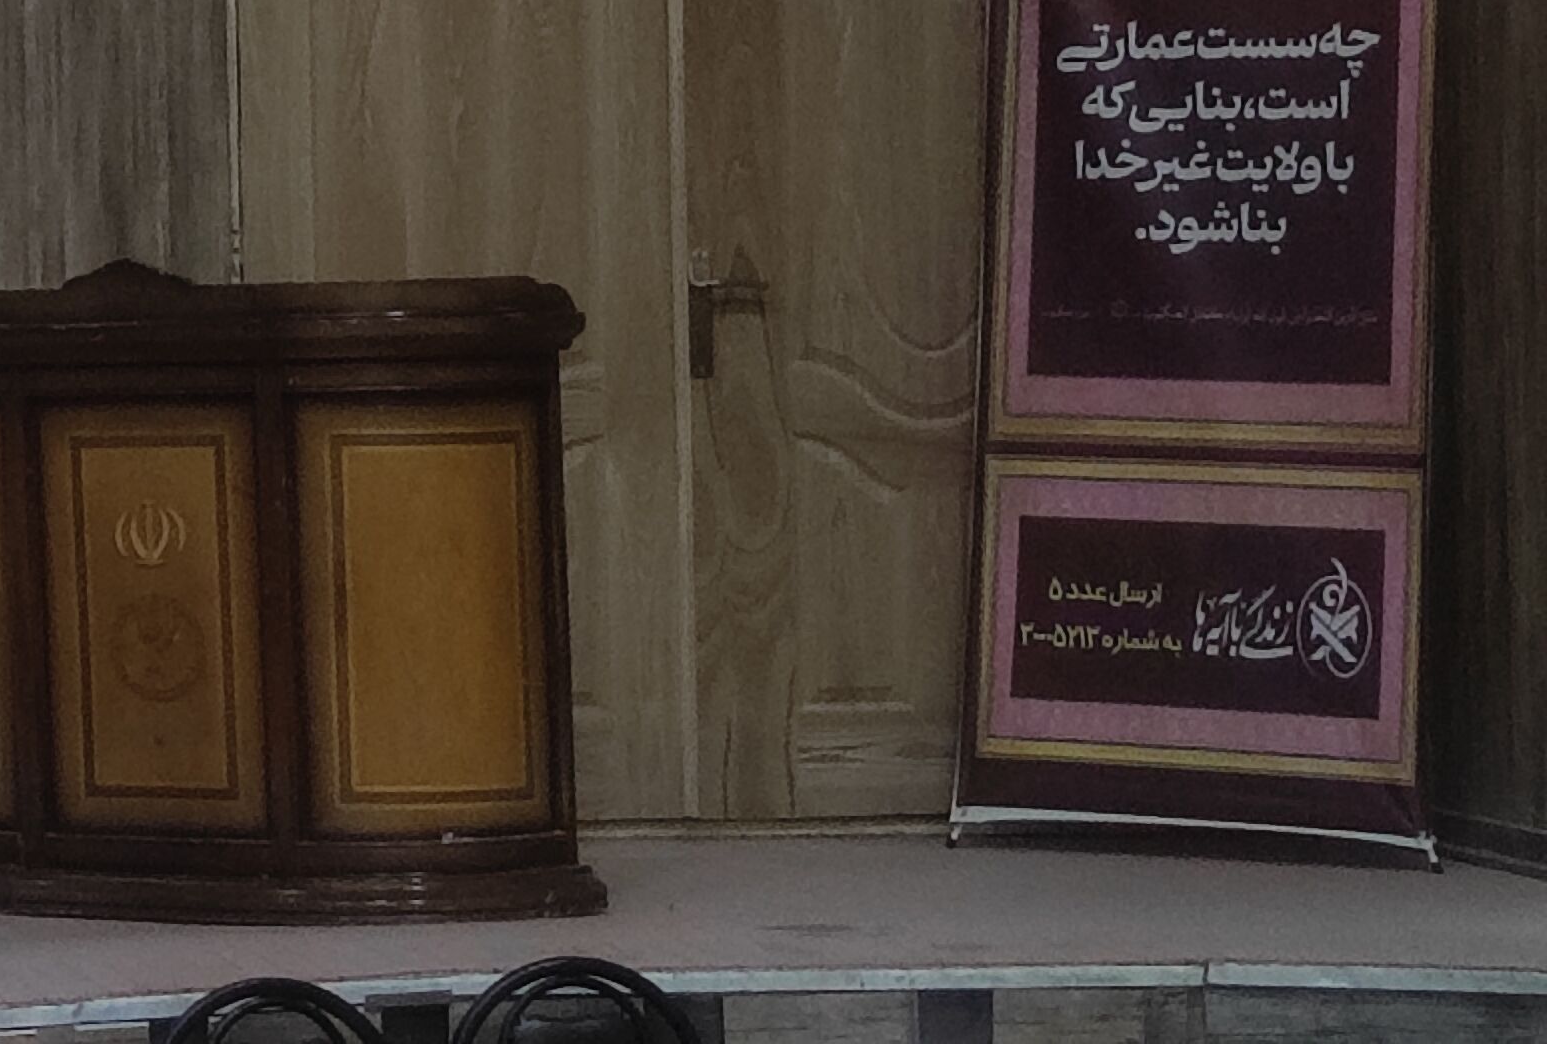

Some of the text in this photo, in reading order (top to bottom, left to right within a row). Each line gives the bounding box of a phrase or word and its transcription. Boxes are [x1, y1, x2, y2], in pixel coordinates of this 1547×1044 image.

[1057, 20, 1381, 78] چه سست عمارتی
[1081, 80, 1136, 119] که
[1128, 80, 1242, 133] بنایی
[1075, 139, 1354, 194] با ولایت غیر خدا
[1134, 201, 1287, 255] بنا شود.
[1048, 576, 1163, 608] ارسال عدد ۵
[1101, 628, 1160, 655] شماره
[1162, 634, 1183, 658] به
